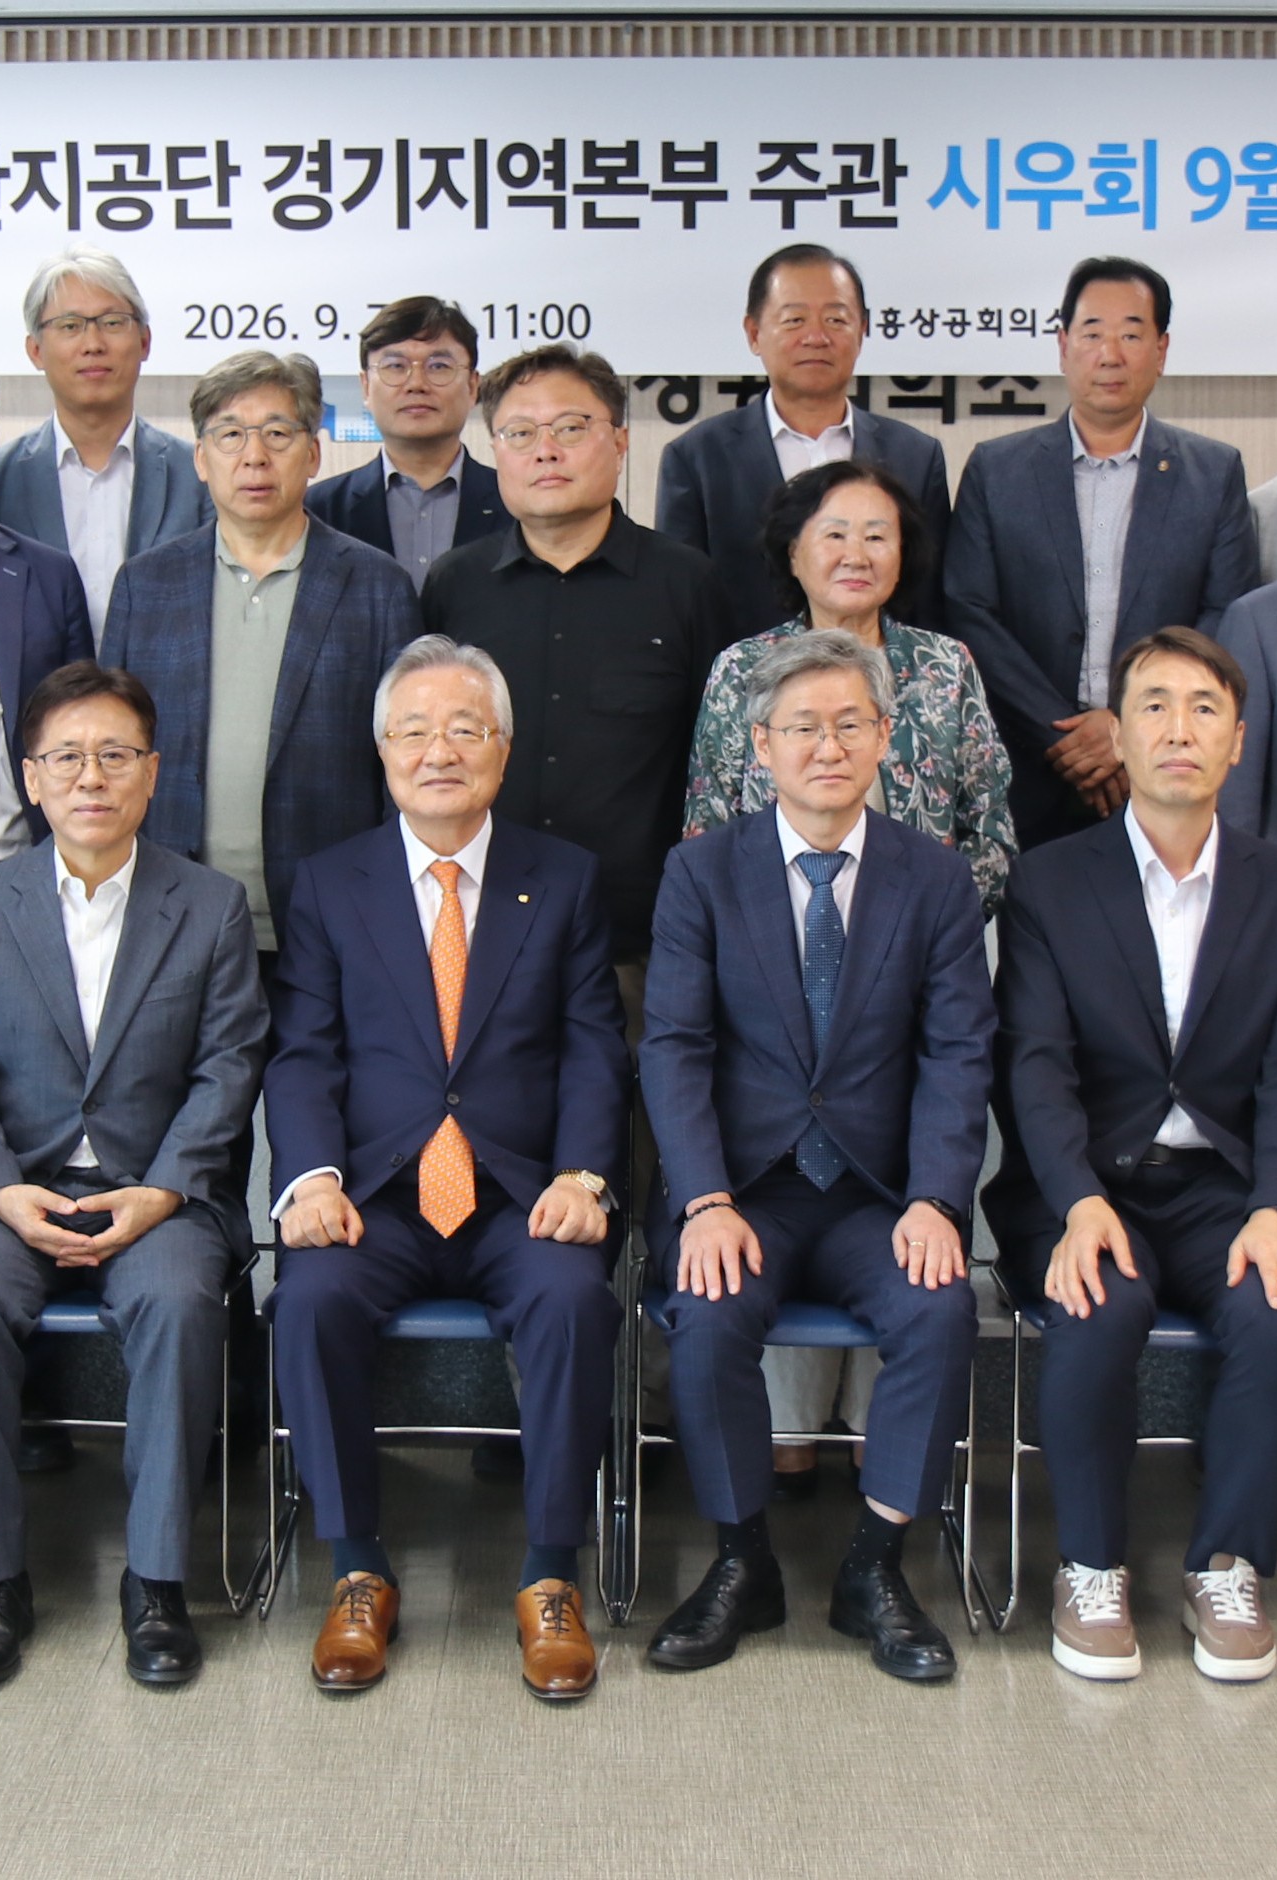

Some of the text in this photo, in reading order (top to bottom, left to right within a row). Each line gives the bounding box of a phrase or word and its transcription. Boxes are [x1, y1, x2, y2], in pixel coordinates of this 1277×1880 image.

[262, 136, 730, 231] 경기지역본부
[748, 136, 910, 231] 주관
[926, 136, 1160, 232] 시우회
[184, 303, 592, 341] 2026. 9. 11:00
[865, 306, 1062, 340] 흥상공회의소
